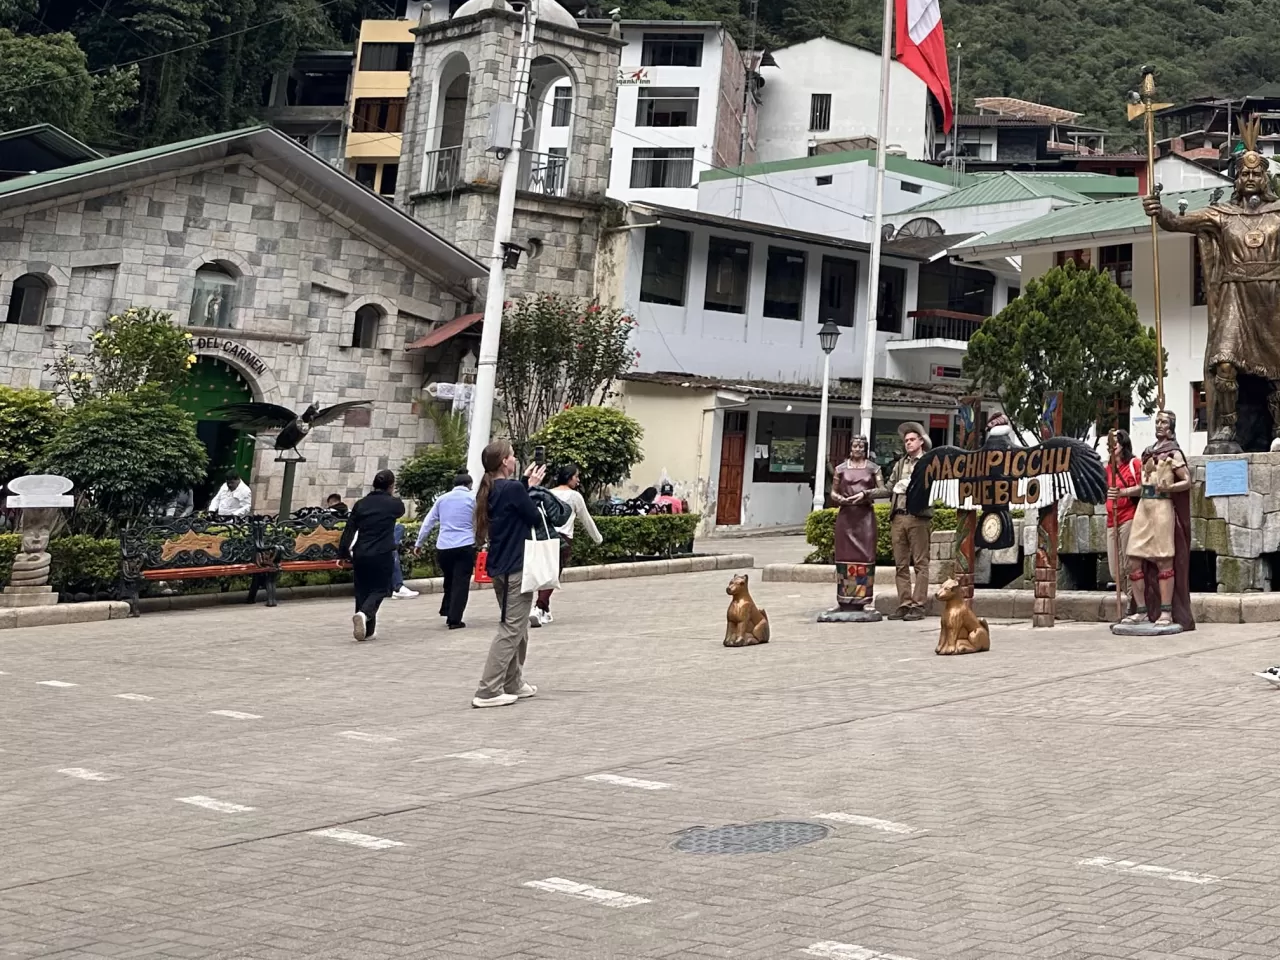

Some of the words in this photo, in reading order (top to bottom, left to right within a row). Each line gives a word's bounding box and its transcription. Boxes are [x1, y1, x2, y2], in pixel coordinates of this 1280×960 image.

[197, 337, 219, 349] DEL
[223, 340, 267, 375] CARMEN
[959, 478, 1041, 506] PUEBLO
